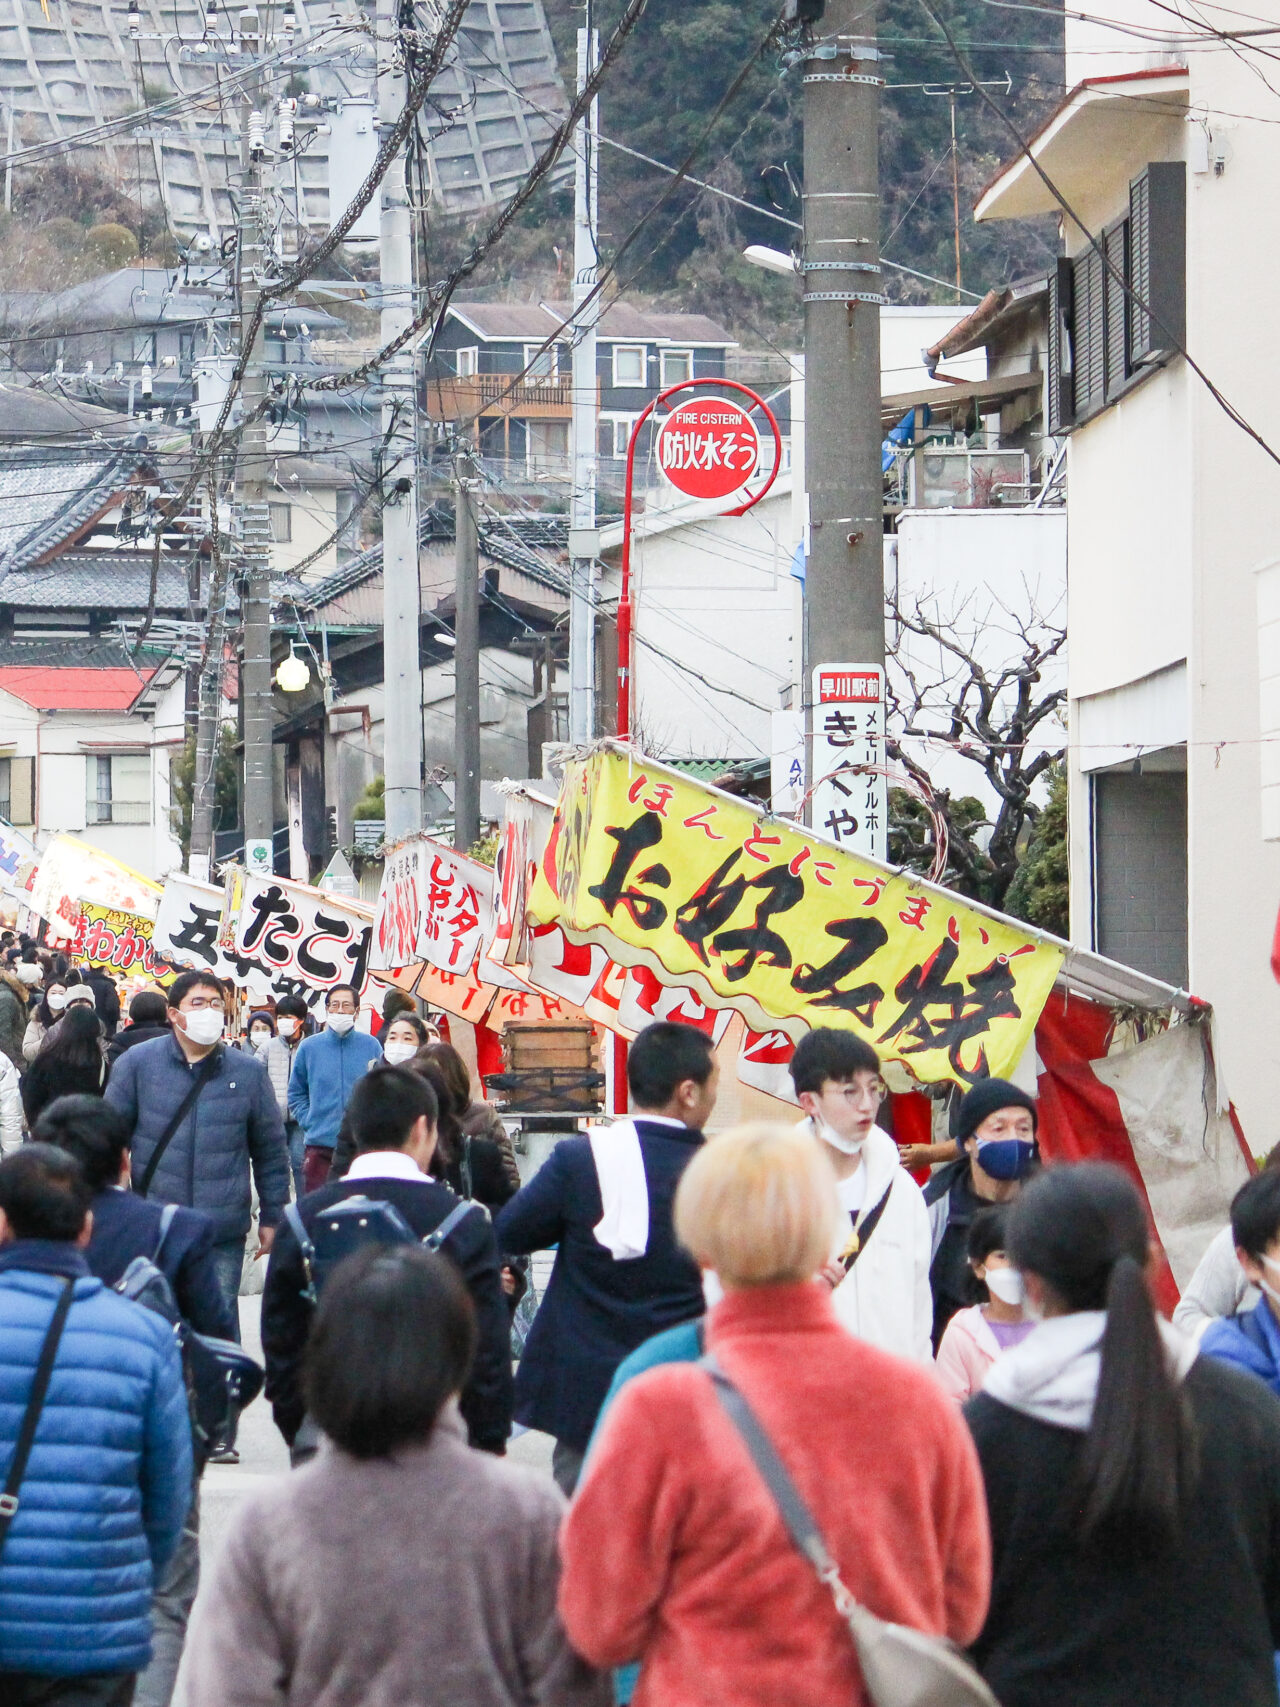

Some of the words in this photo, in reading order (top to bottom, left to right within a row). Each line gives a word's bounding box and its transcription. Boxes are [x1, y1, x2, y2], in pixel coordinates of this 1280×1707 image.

[676, 413, 698, 424] FIRE
[700, 413, 742, 425] CISTERN
[663, 431, 757, 471] 防火水そう
[821, 678, 880, 699] 早川駅前
[824, 710, 859, 841] きくや
[865, 710, 879, 857] メモリアルホー
[447, 883, 484, 966] バター
